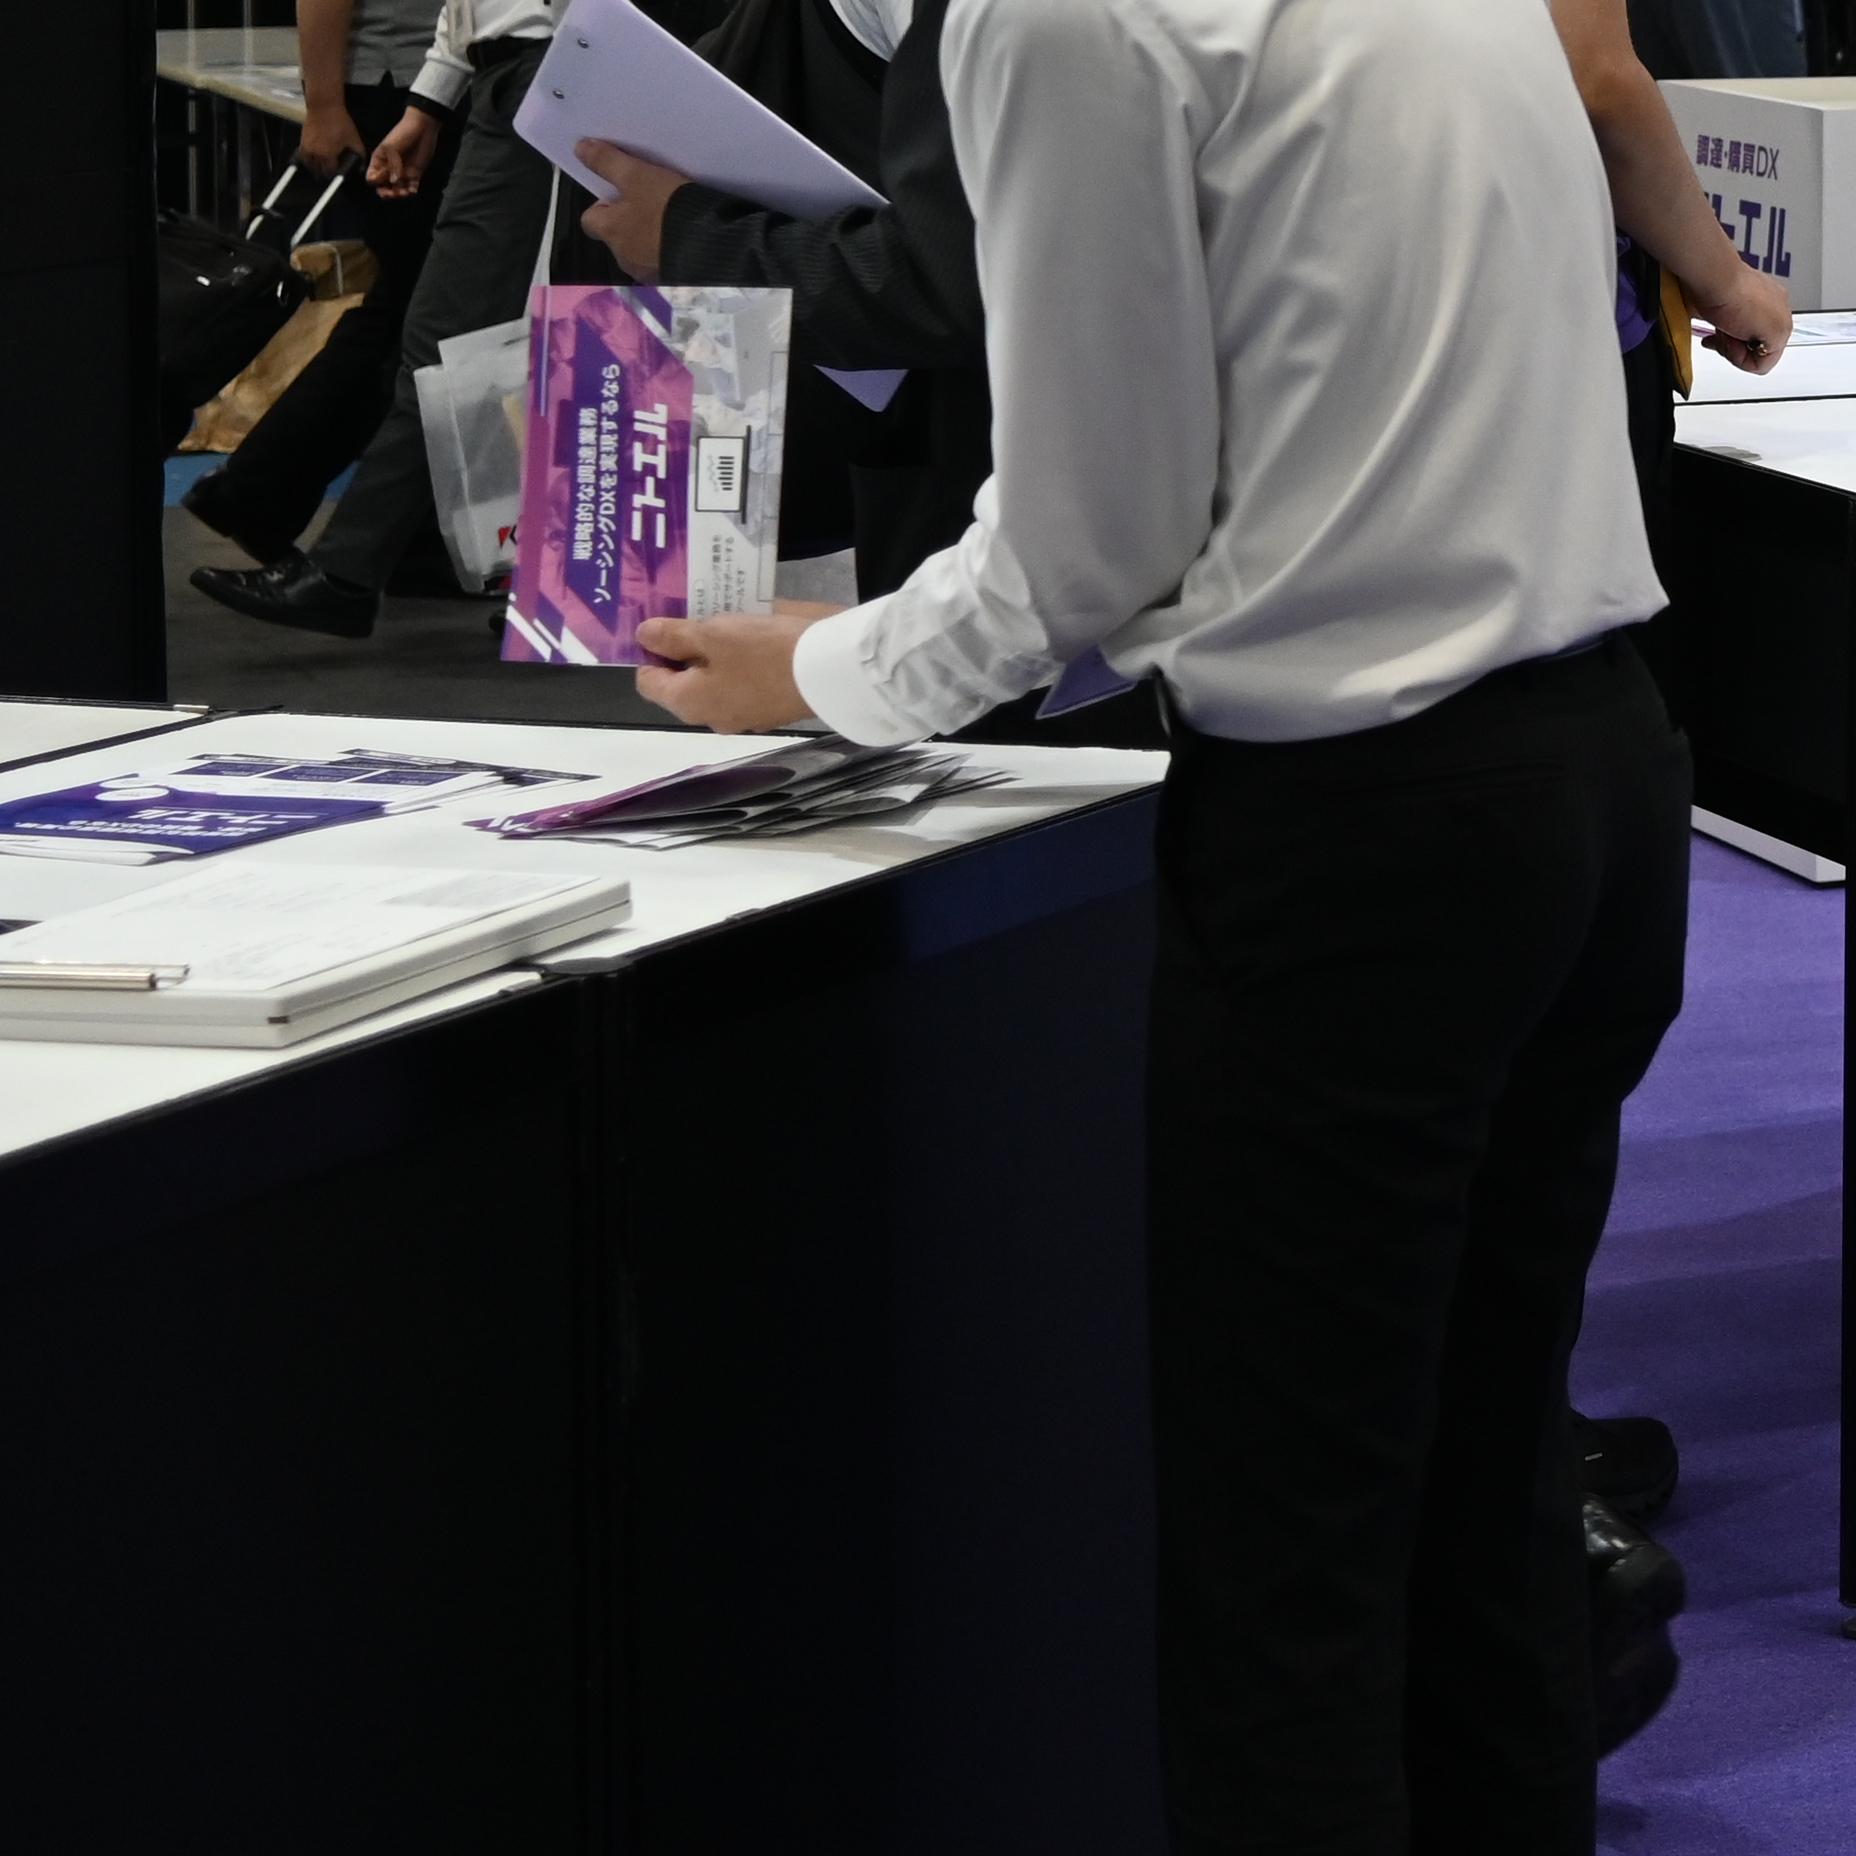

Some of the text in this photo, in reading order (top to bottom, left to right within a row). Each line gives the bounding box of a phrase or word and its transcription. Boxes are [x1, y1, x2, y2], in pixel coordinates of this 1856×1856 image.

[1696, 134, 1780, 180] 調達・購買DX
[573, 406, 598, 562] 戦略的な調達業務
[591, 362, 622, 605] ソーシングDXを実現するなら
[631, 401, 669, 549] ニトエル
